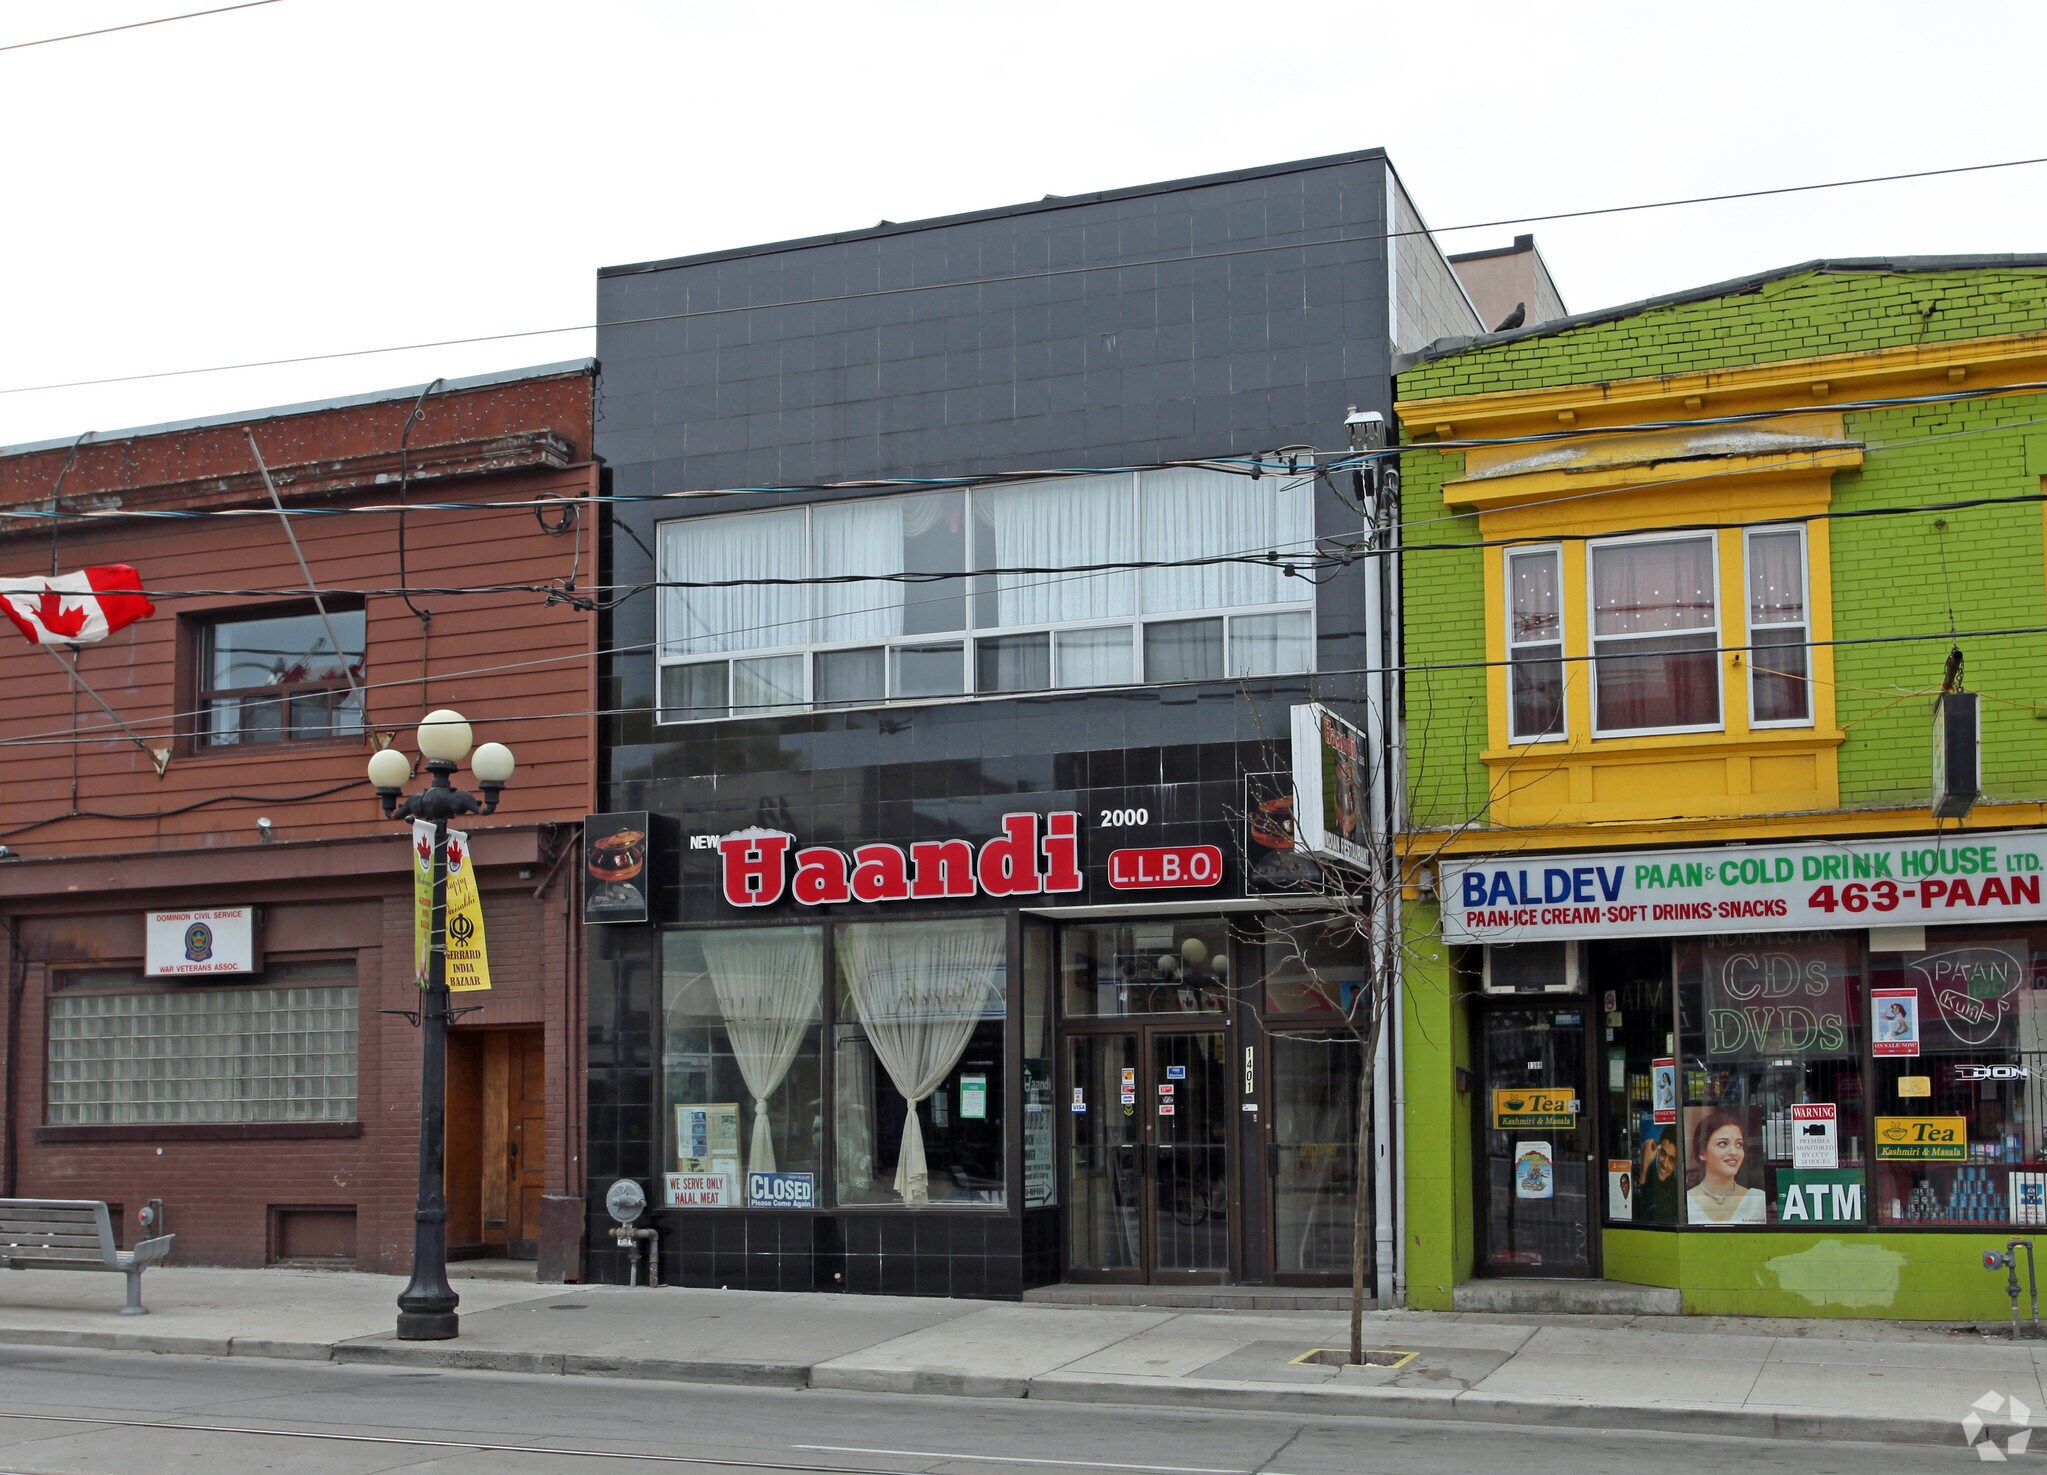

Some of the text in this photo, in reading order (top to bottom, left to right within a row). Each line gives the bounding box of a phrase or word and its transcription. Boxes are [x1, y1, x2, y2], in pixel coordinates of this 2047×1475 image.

[1100, 808, 1149, 827] 2000
[689, 834, 720, 850] NEW
[716, 810, 1083, 907] Haandi
[1112, 852, 1219, 883] L.L.B.O.
[1463, 846, 2044, 907] BALDEV PAAN & COLD DRINK HOUSE LTD.
[446, 877, 469, 897] appy
[1808, 875, 2041, 913] 463-PAAN
[156, 910, 242, 922] DOMINION CIVIL SERVICE
[159, 962, 239, 973] WAR VETERANS ASSOC.
[453, 963, 474, 973] INDIA
[1722, 952, 1829, 1001] CDs
[1935, 960, 2008, 982] PAAN
[450, 976, 481, 987] BAZAAR
[1708, 1005, 1844, 1054] DVDs
[1528, 1095, 1565, 1112] Tea
[1793, 1107, 1834, 1118] WARNING
[1501, 1117, 1571, 1125] Kashmiri & Masala
[1912, 1123, 1955, 1142] Tea
[1881, 1147, 1961, 1156] Kashmiri & Masala
[670, 1177, 724, 1190] WE SERVE ONLY
[751, 1175, 811, 1200] CLOSED
[675, 1192, 719, 1204] HALAL MEAT
[751, 1199, 772, 1207] Please
[793, 1200, 811, 1208] Again
[1782, 1184, 1862, 1221] ATM
